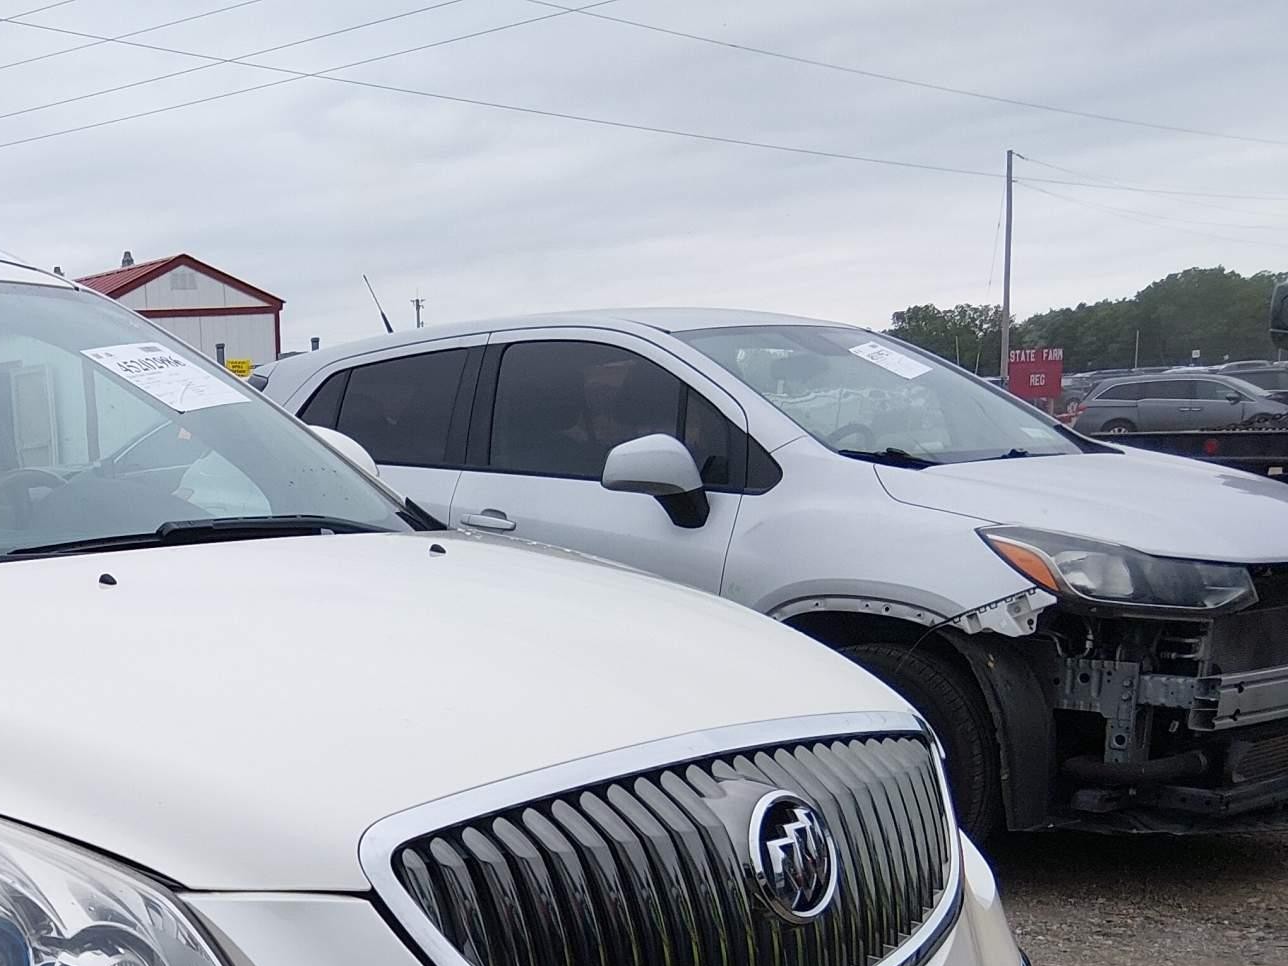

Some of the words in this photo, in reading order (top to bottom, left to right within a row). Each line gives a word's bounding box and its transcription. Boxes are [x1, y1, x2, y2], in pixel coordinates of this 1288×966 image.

[1009, 349, 1036, 362] STATE
[1042, 348, 1064, 361] FARM
[1029, 374, 1046, 386] REG
